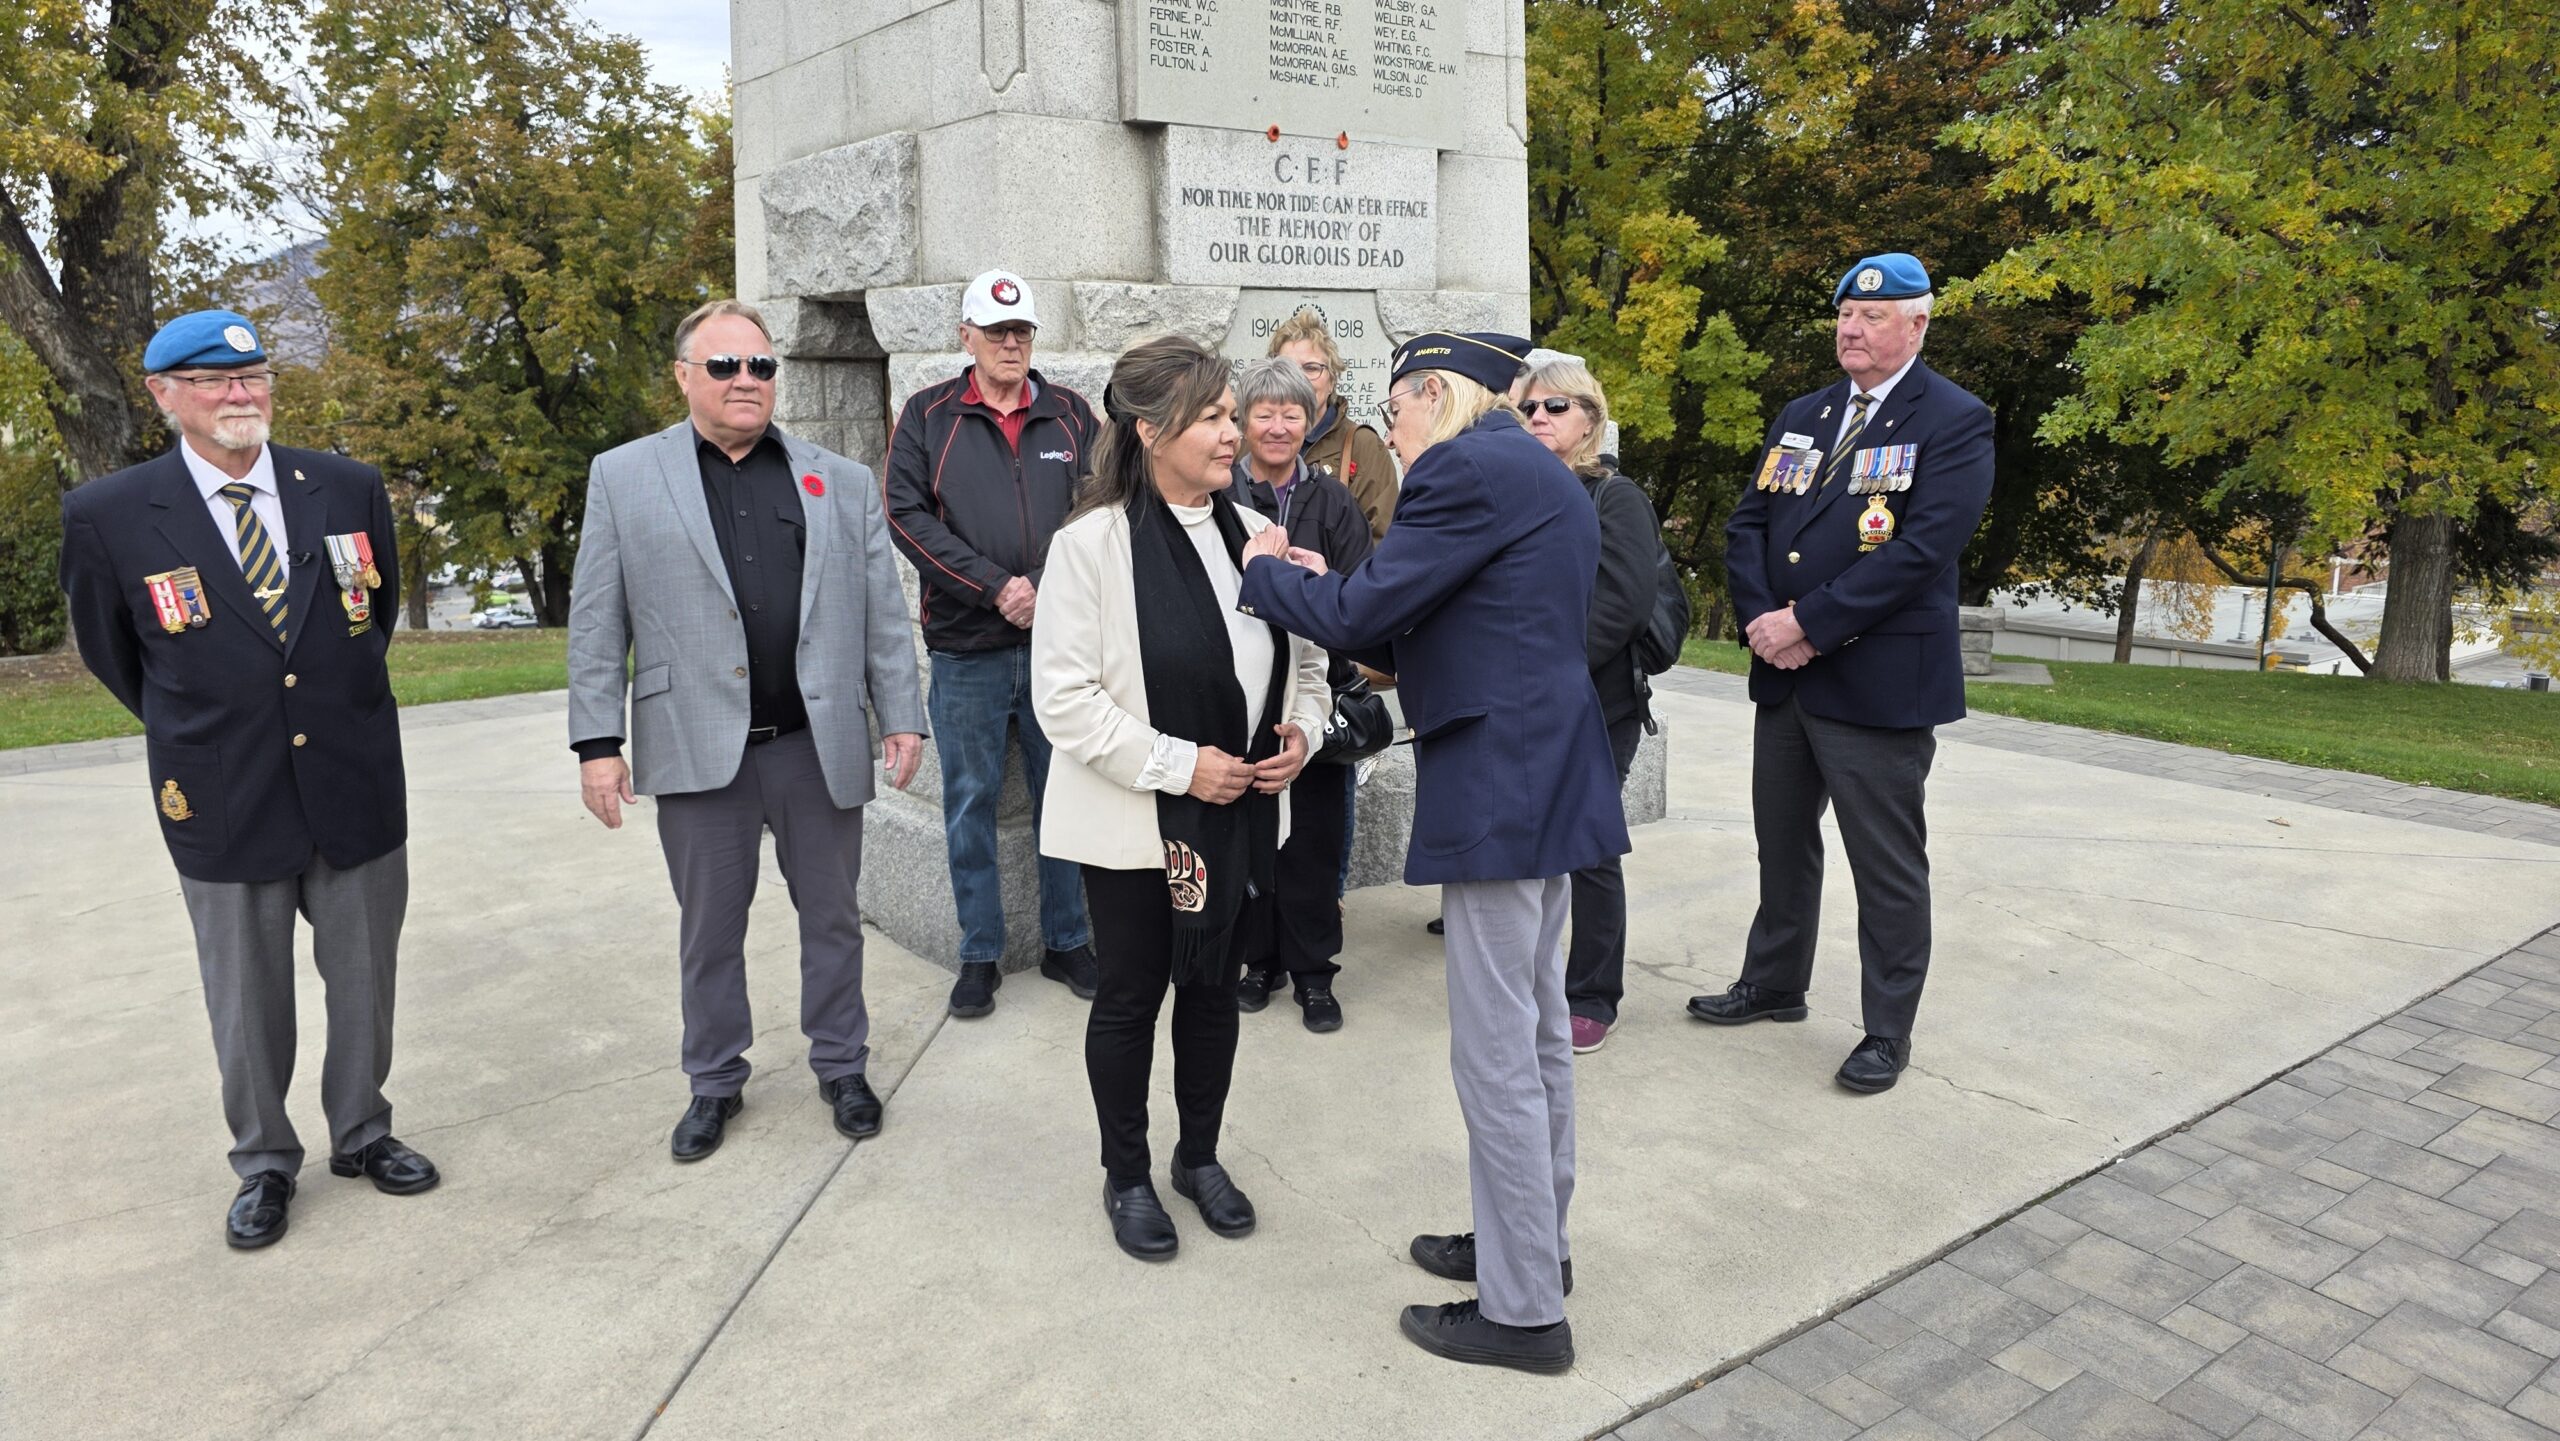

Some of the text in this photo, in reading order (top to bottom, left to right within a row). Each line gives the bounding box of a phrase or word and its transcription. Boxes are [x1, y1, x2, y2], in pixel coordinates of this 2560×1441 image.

[1182, 187, 1214, 207] NOR
[1217, 190, 1253, 209] TIME
[1256, 192, 1287, 211] NOR
[1289, 194, 1320, 213] TIDE
[1322, 196, 1353, 214] CAN
[1386, 199, 1428, 218] EFFACE
[1235, 216, 1381, 242] THE MEMORY OF
[1209, 242, 1404, 268] OUR GLORIOUS DEAD
[1252, 318, 1280, 338] 1914
[1335, 319, 1364, 338] 1918
